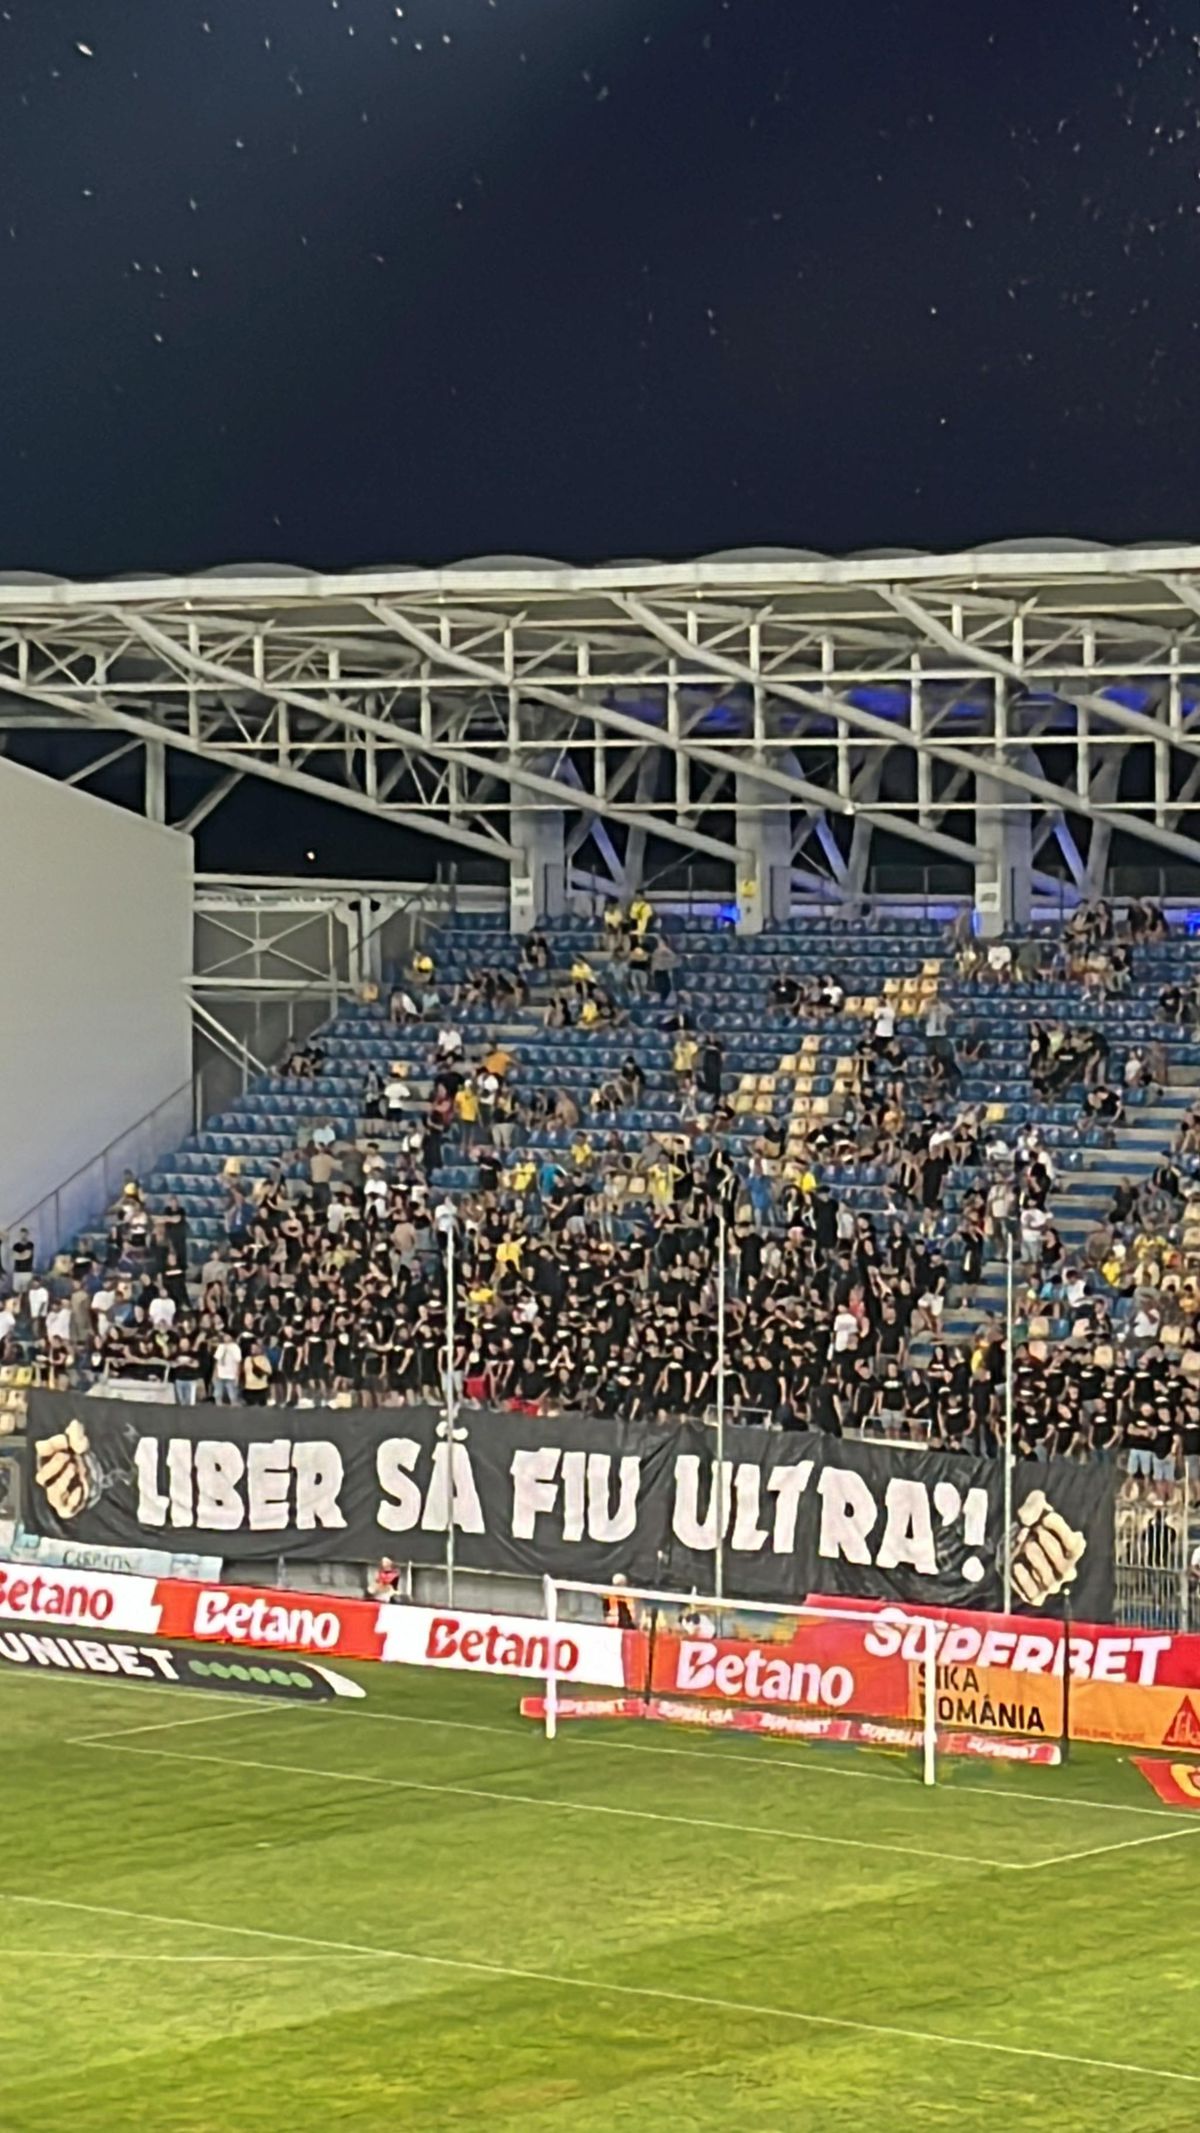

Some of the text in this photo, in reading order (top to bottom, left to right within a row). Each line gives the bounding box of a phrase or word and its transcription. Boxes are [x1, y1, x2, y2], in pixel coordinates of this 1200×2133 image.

[135, 1437, 347, 1531] LIBER
[376, 1419, 486, 1534] SĂ
[510, 1447, 641, 1543] FIU
[0, 1570, 114, 1620] etano
[193, 1591, 340, 1647] Betano
[0, 1632, 180, 1680] UNIBET
[425, 1617, 579, 1672] Betano
[863, 1607, 1172, 1686] SUPERBET
[676, 1639, 854, 1707] Betano
